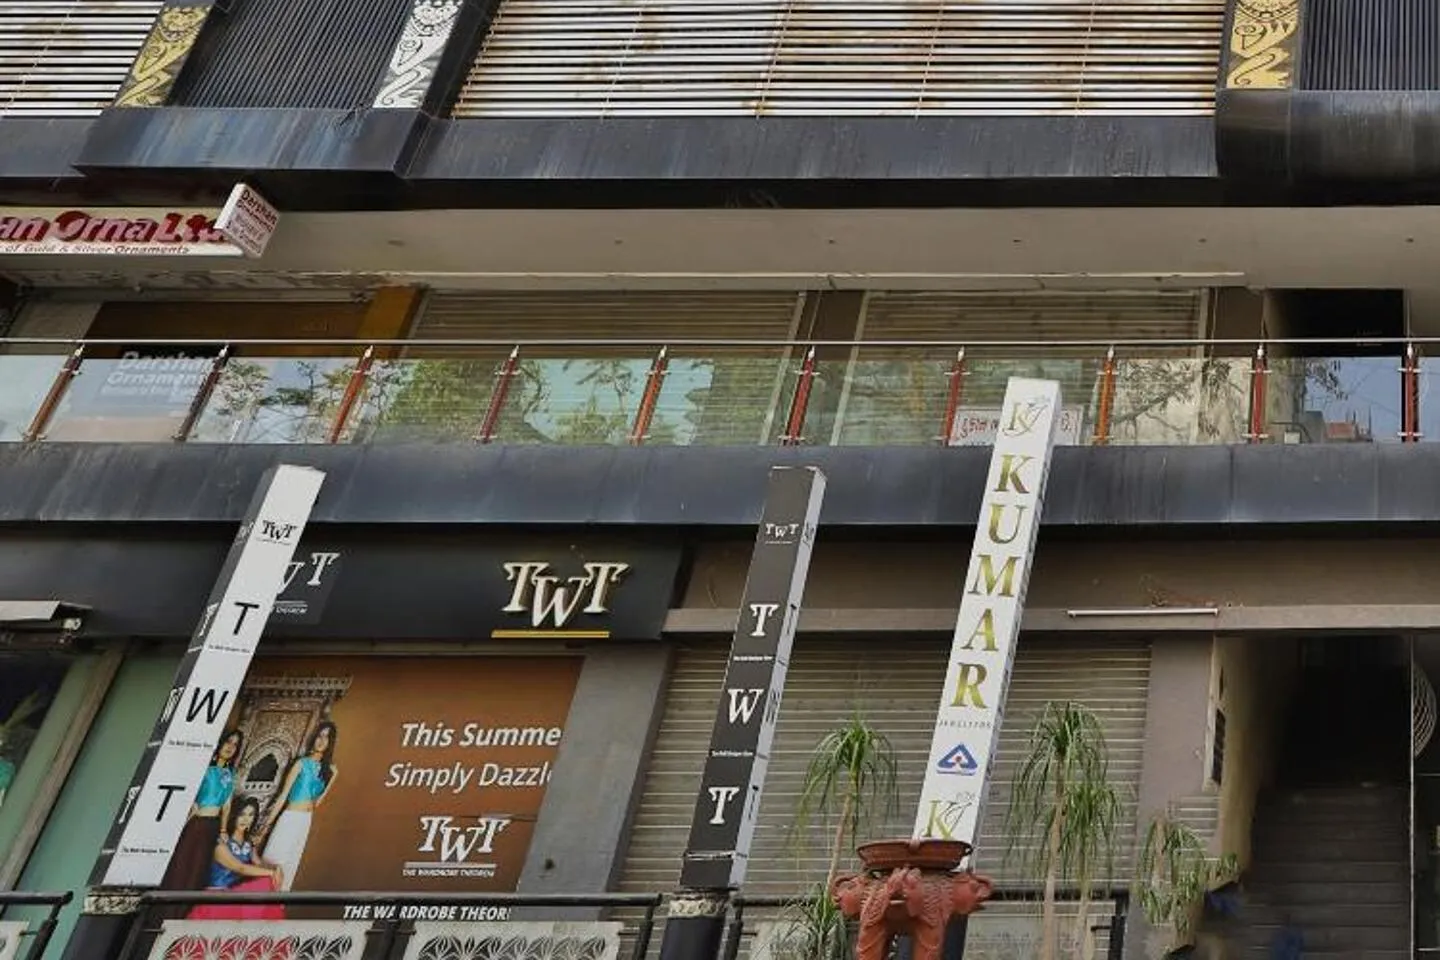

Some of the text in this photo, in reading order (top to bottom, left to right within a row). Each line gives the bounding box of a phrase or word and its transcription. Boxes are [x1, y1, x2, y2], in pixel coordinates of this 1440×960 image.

[500, 562, 630, 627] TWT
[949, 453, 1036, 710] KUMAR
[400, 721, 455, 748] This
[385, 762, 475, 794] Simply
[418, 815, 512, 863] TWT
[342, 905, 371, 920] THE
